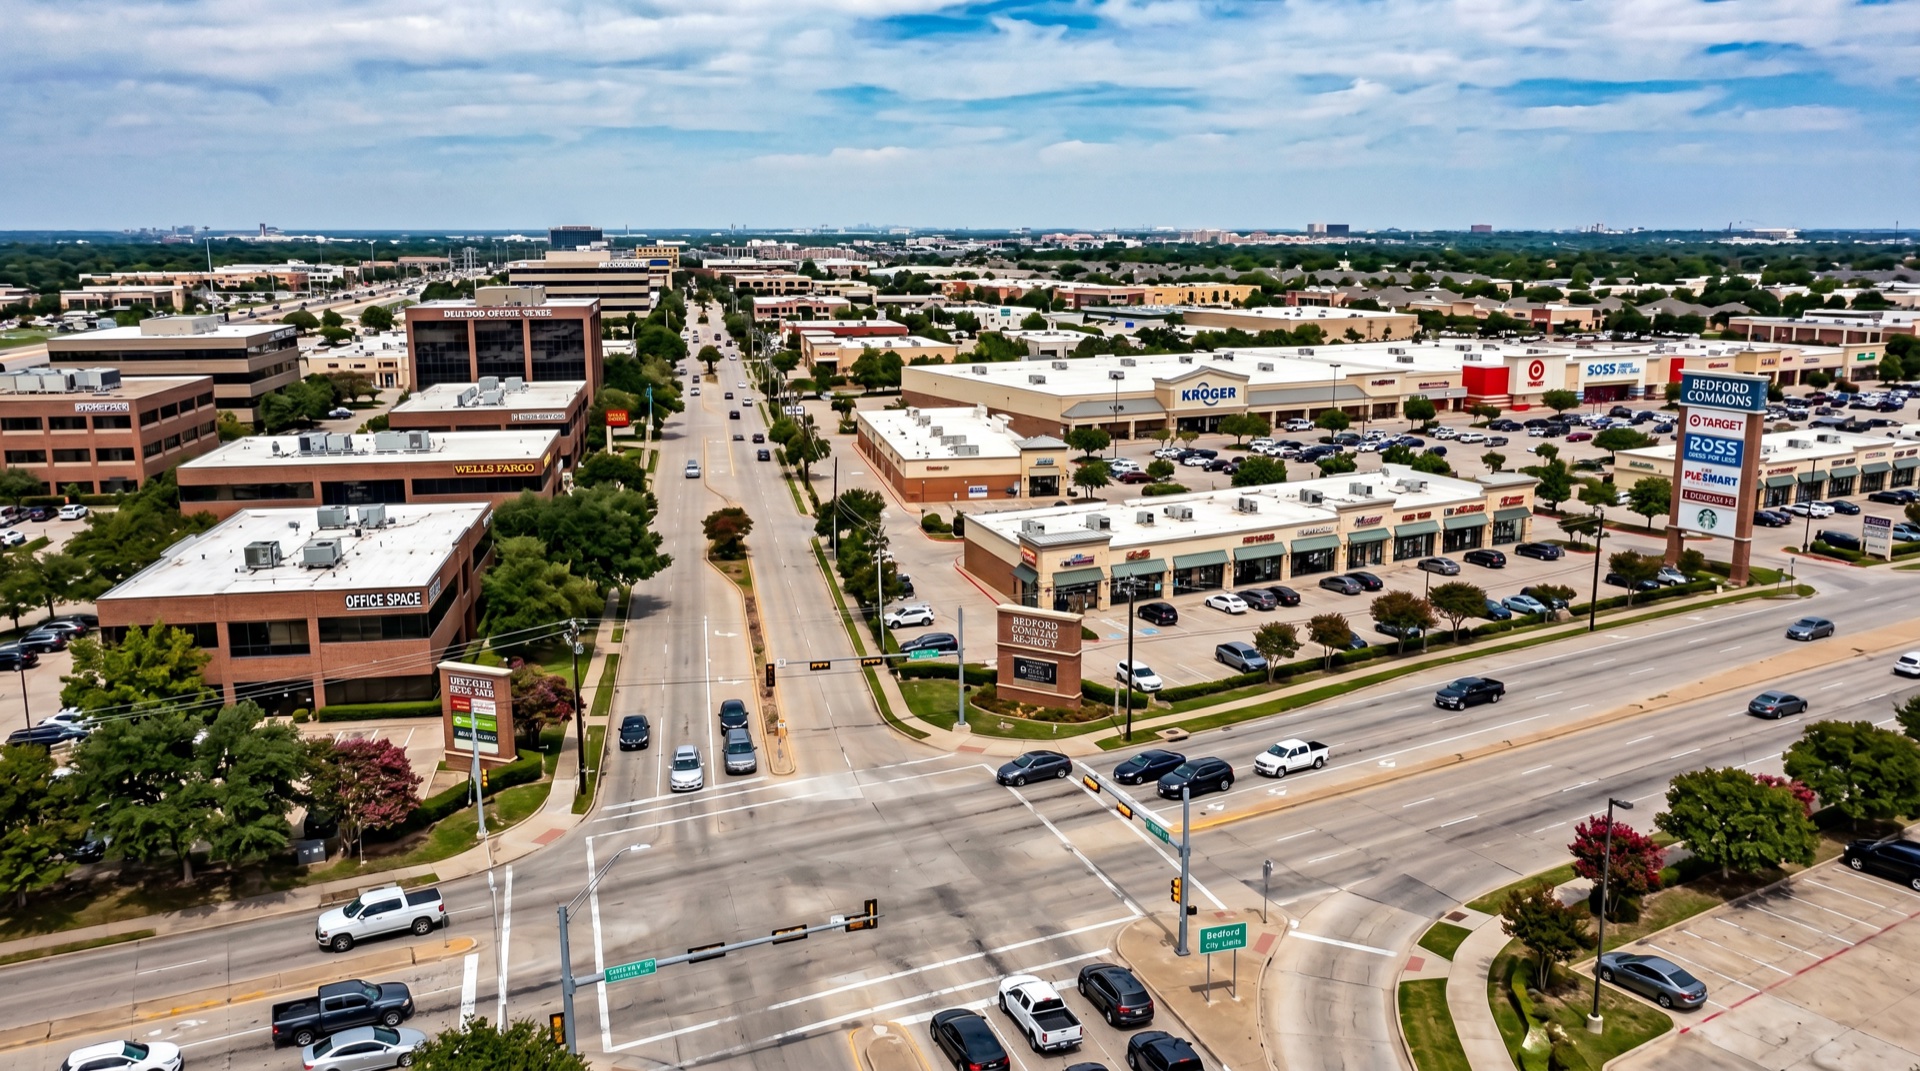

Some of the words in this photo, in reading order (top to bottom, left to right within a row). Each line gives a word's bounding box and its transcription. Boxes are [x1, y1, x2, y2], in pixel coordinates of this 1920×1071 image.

[1182, 387, 1236, 401] KROGER
[1692, 378, 1749, 395] BEDFORD
[1687, 390, 1752, 408] COMMONS
[1702, 416, 1743, 431] TARGET
[454, 464, 494, 474] WELLS
[496, 463, 535, 473] FARGO
[345, 593, 384, 608] OFFICE
[386, 592, 421, 606] SPACE
[1206, 928, 1240, 940] Bedford
